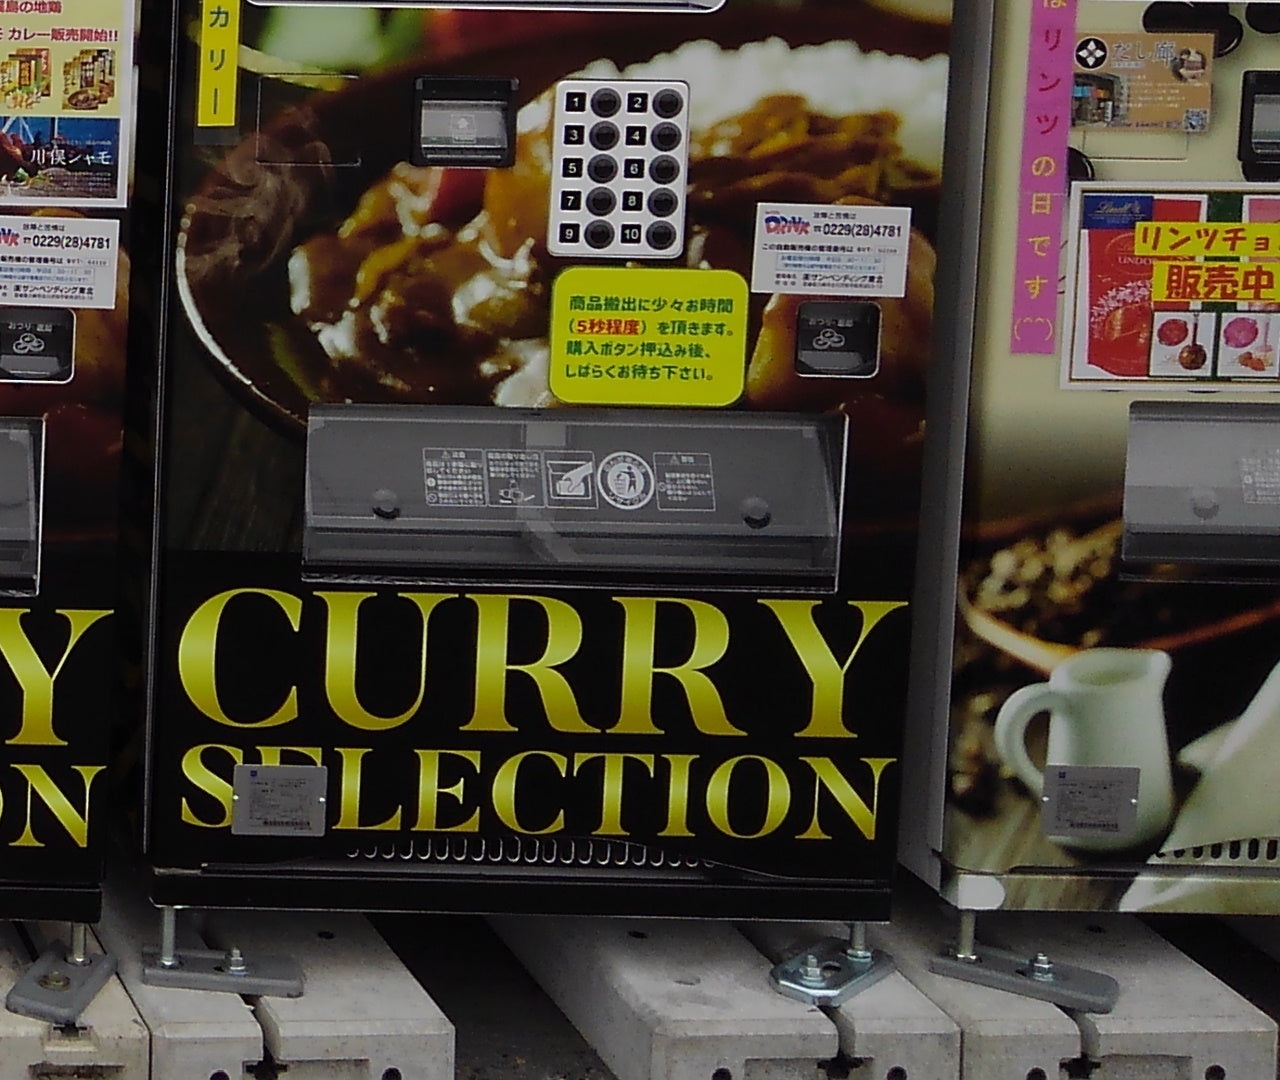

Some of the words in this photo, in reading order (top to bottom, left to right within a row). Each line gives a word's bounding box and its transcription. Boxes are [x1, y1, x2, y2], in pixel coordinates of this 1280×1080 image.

[30, 150, 112, 165] 川俣シャモ
[823, 223, 902, 238] 0229(28)4781
[33, 234, 110, 249] 0229(28)4781
[1166, 265, 1274, 299] 販売中
[570, 295, 733, 313] 商品搬出に少々お時間
[565, 364, 713, 381] しばらくお待ち下さい。
[178, 588, 909, 738] CURRY
[180, 744, 897, 841] SLECTION
